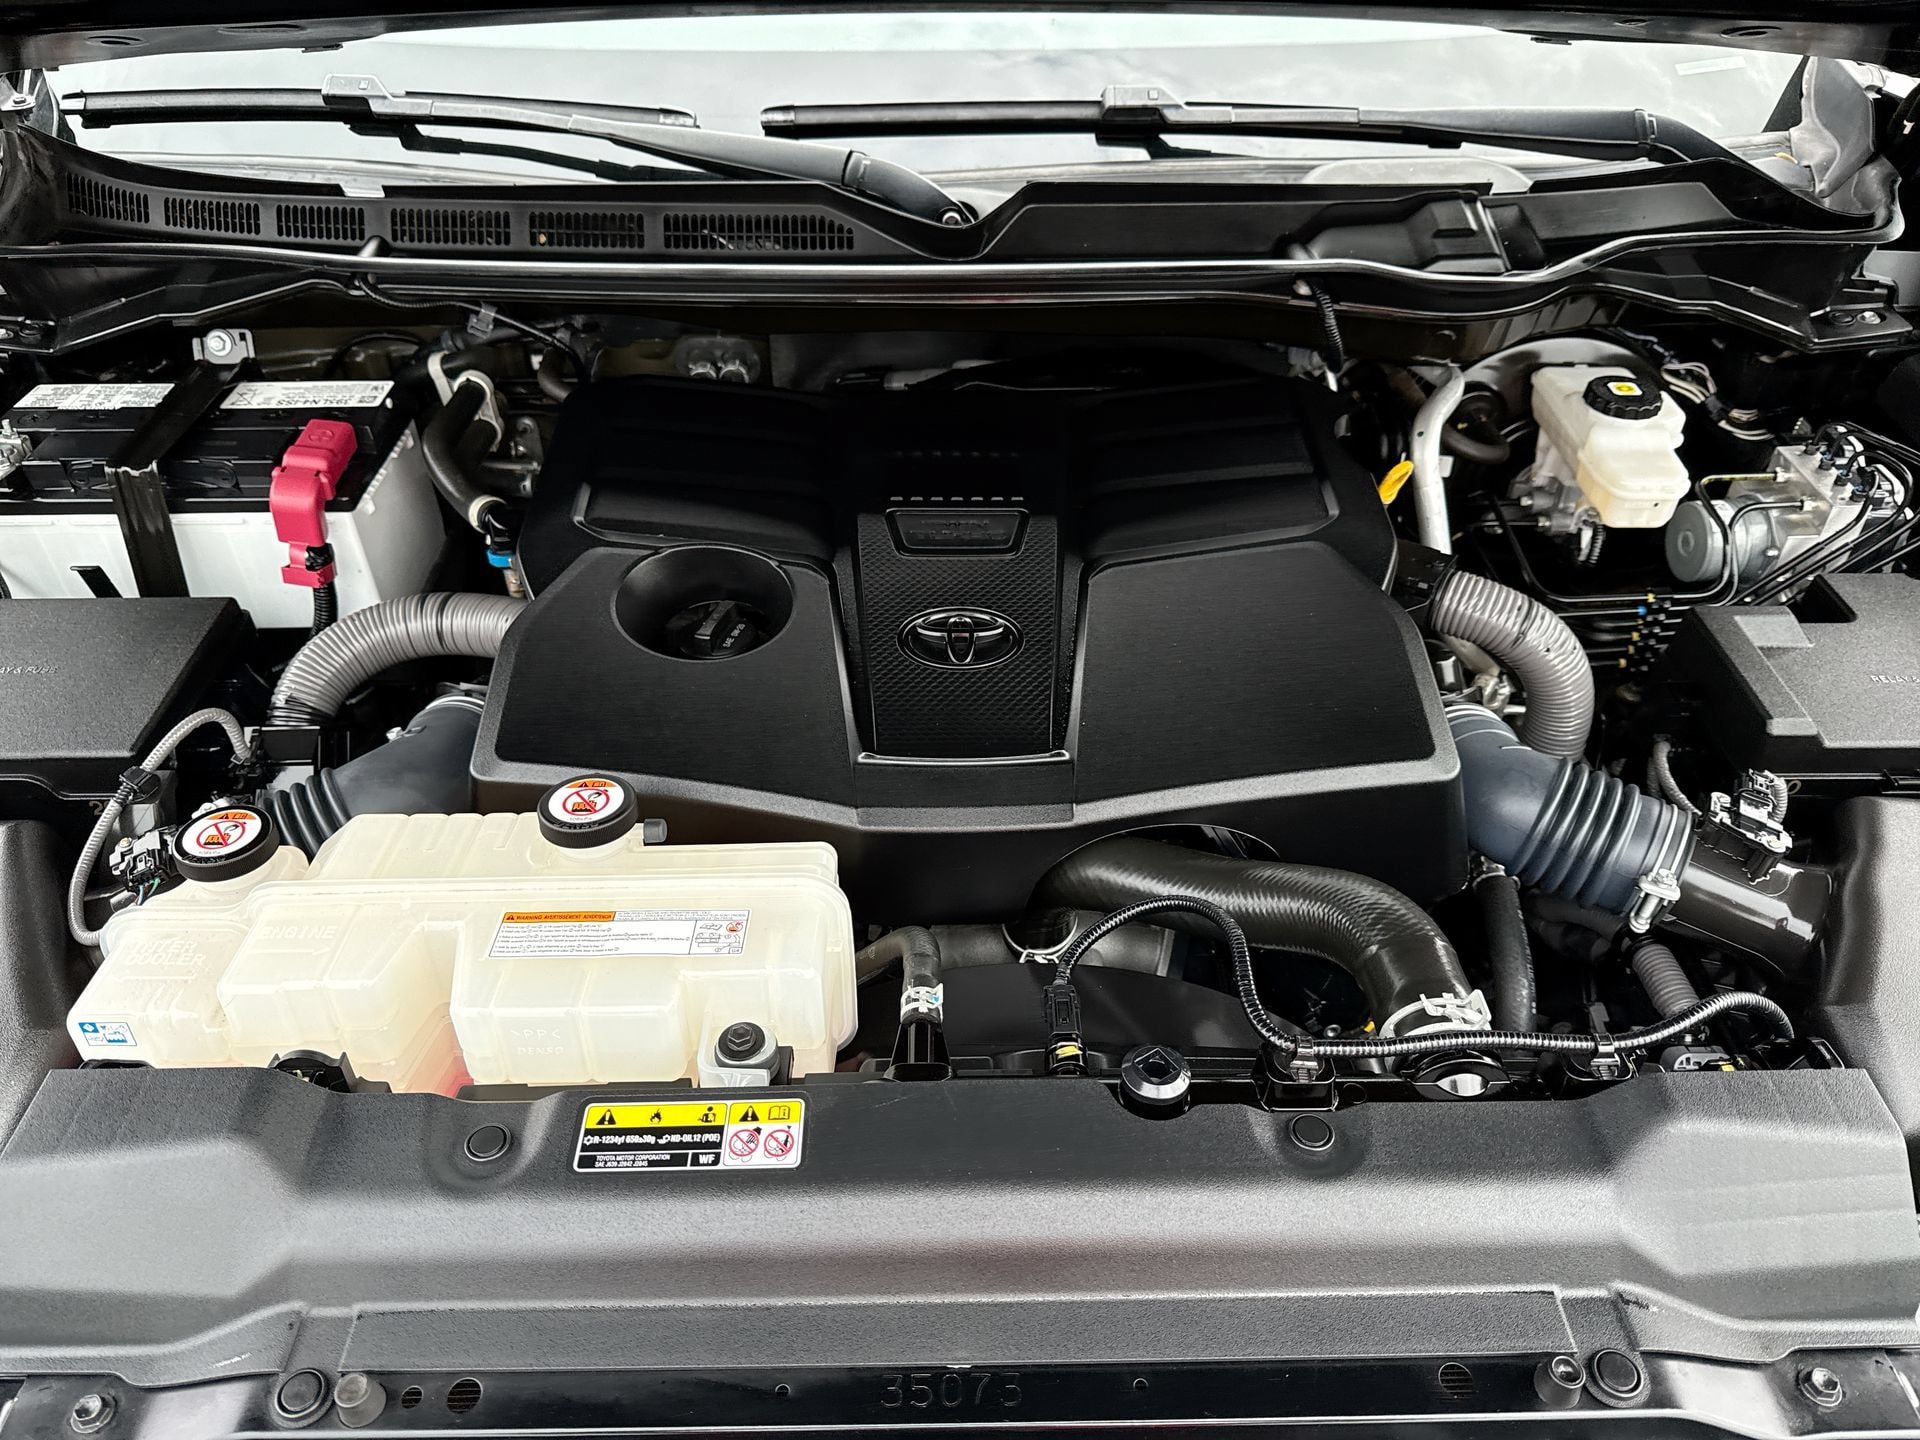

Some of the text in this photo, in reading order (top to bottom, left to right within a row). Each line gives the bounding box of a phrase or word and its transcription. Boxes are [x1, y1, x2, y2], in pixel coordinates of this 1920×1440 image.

[258, 925, 338, 940] ENGINE
[125, 953, 206, 966] COOLER
[517, 1047, 564, 1057] DENSO
[593, 1135, 625, 1145] R-1234yf
[702, 1133, 721, 1143] (POE)
[699, 1154, 715, 1164] WF
